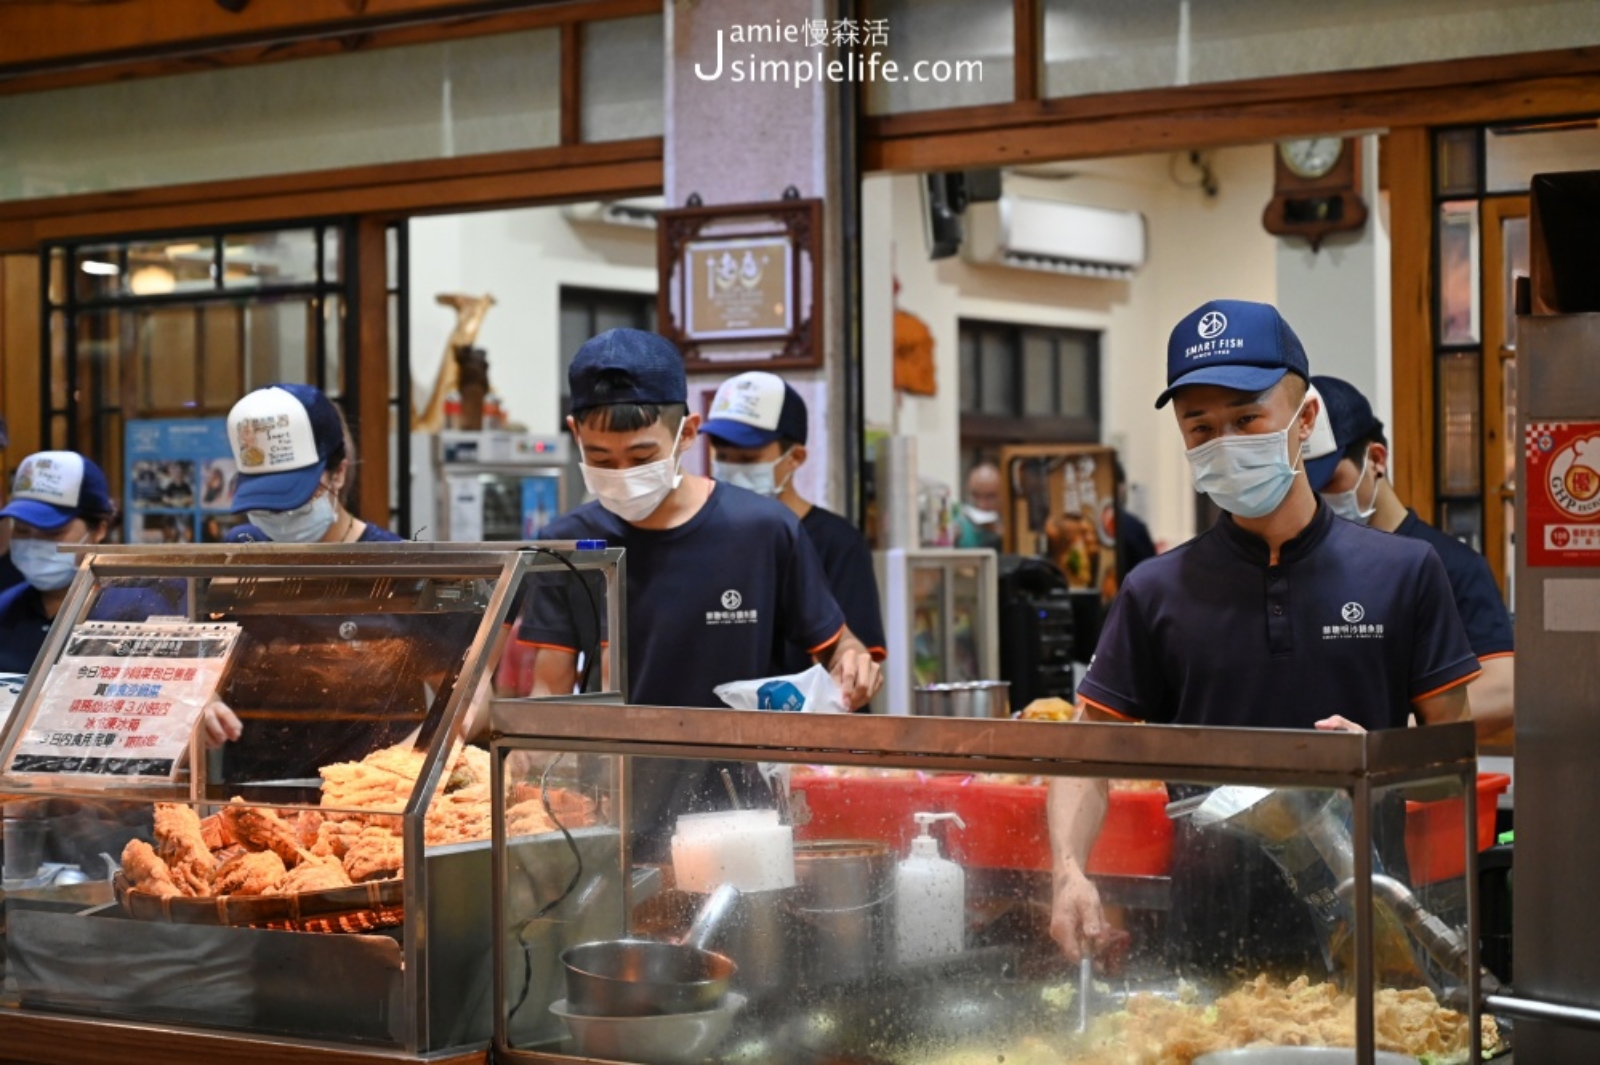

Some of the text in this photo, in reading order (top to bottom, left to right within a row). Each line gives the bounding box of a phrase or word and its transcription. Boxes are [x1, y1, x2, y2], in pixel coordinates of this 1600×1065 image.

[1185, 340, 1216, 358] SMART
[1219, 338, 1244, 349] FISH
[1551, 476, 1577, 509] GHP
